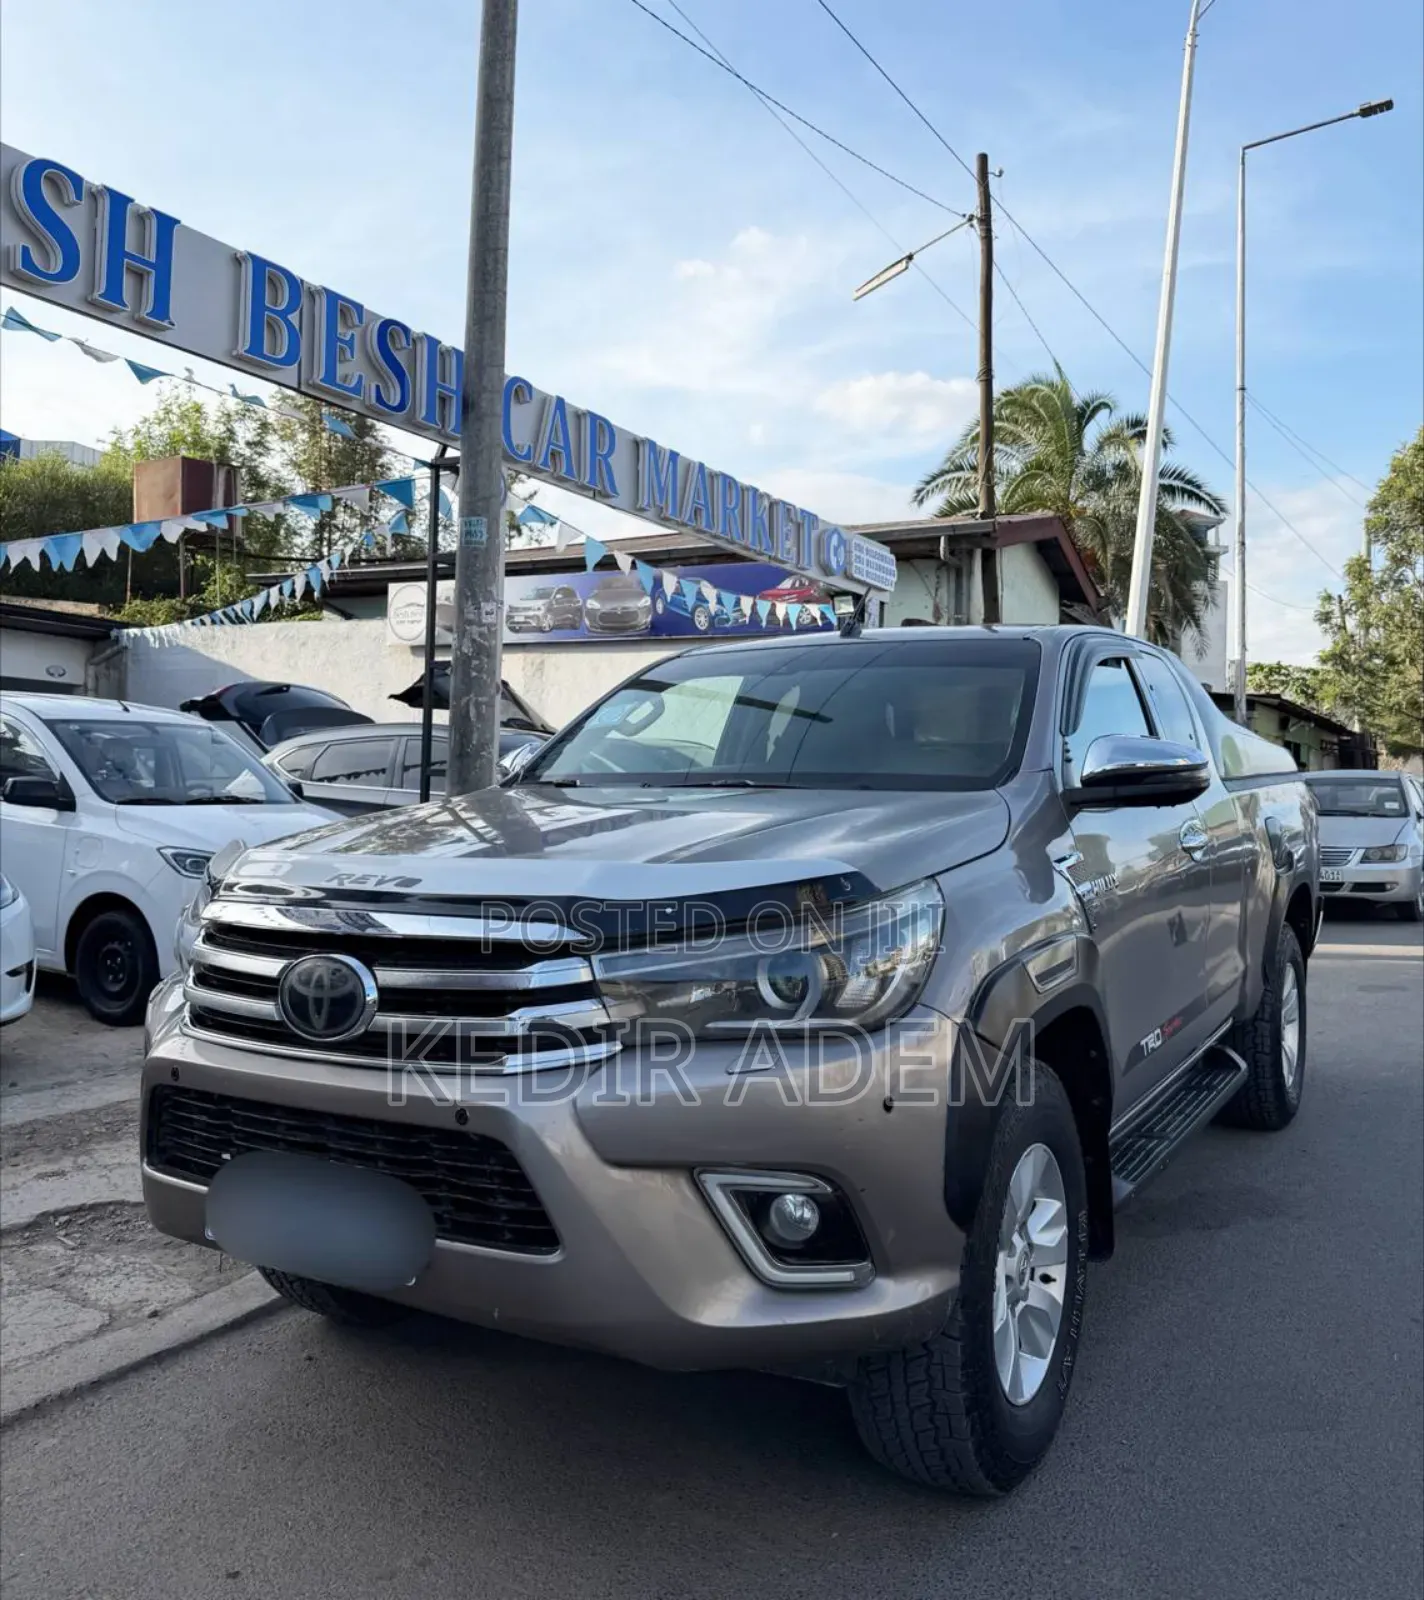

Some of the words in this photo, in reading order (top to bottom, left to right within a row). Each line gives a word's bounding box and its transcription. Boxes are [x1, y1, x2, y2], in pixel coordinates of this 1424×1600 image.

[12, 157, 182, 332] SH
[234, 250, 465, 436] BESH
[502, 376, 619, 499] CAR
[637, 437, 819, 571] MARKET
[325, 872, 422, 889] REVO
